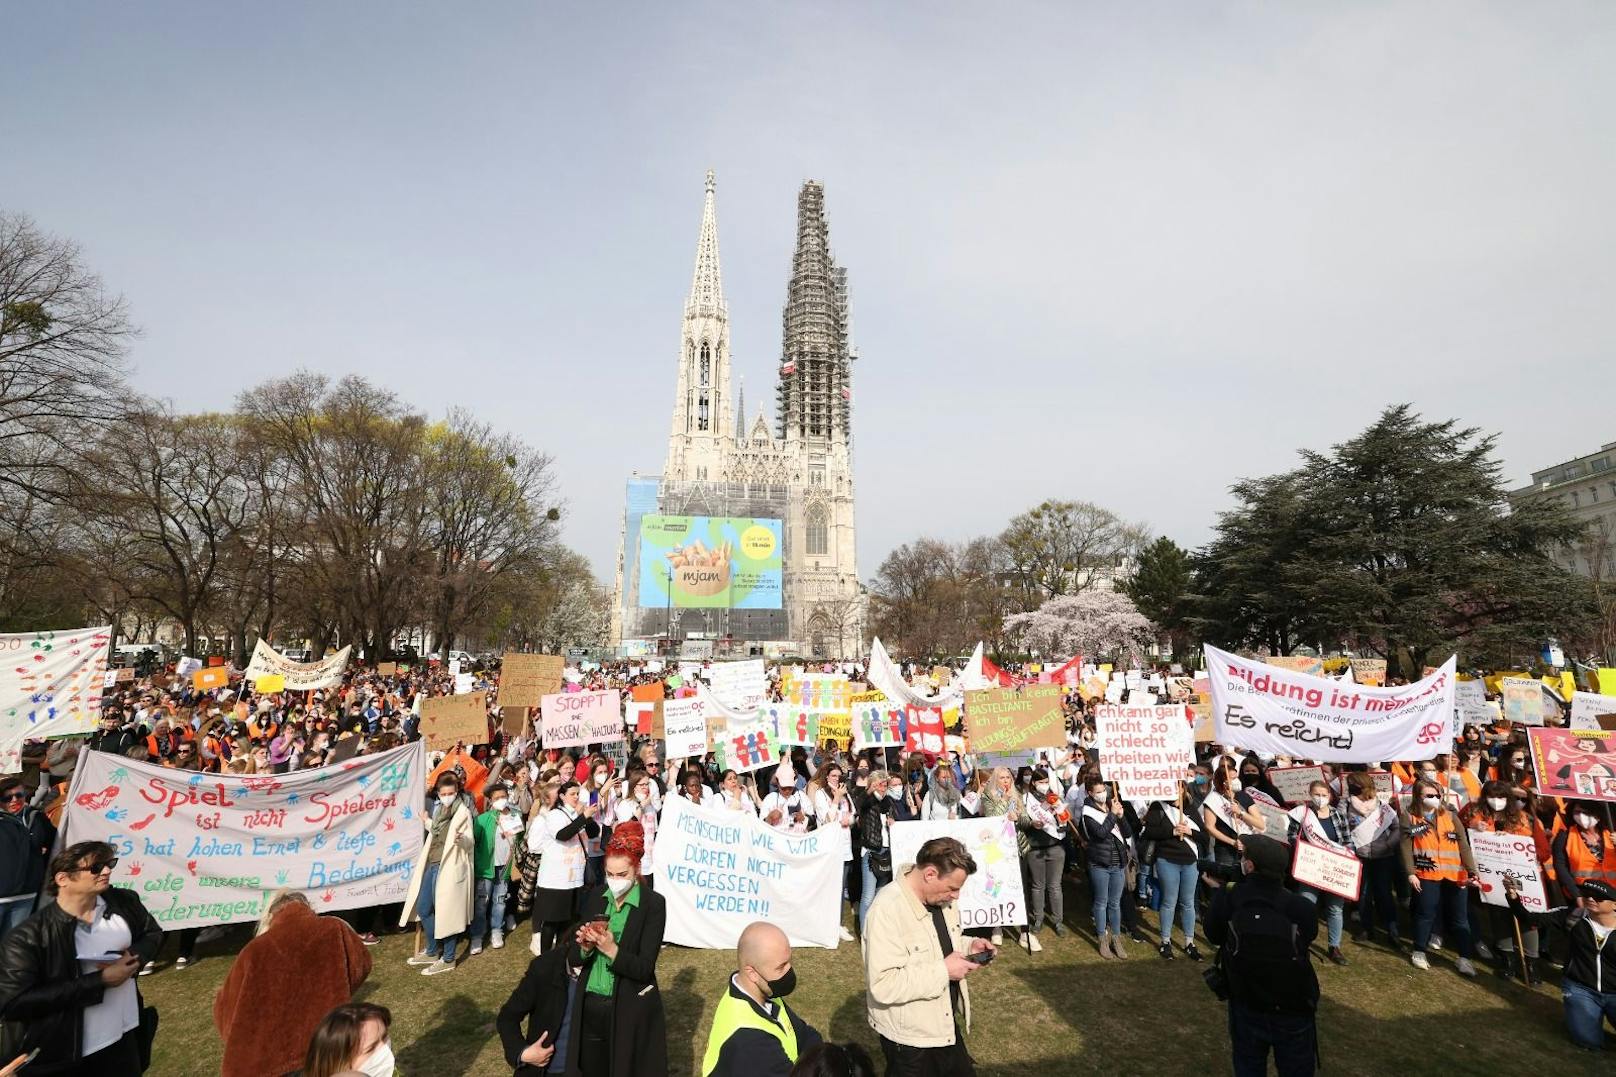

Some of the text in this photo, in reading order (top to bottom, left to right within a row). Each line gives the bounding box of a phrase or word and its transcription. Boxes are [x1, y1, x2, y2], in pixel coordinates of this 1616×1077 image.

[683, 569, 721, 586] mjam
[1001, 689, 1021, 701] bin
[1026, 687, 1058, 699] keine
[1227, 682, 1245, 692] Die
[1332, 714, 1350, 726] der
[1330, 689, 1361, 710] ist
[969, 700, 1033, 715] BASTELTANTE
[1117, 704, 1152, 719] kann
[1155, 706, 1179, 720] gar
[545, 727, 580, 742] MASSEN
[1106, 719, 1168, 734] nicht so
[1224, 703, 1353, 751] Es reicht!
[1105, 733, 1167, 749] schlecht
[1099, 749, 1190, 765] arbeiten wie
[1107, 765, 1189, 781] ich bezahlt
[139, 778, 234, 818] Spiel
[195, 791, 397, 831] ist nicht Spielerei
[676, 812, 741, 844] MENSCHEN
[107, 829, 376, 858] Es hat hohen Ernst & tiefe
[750, 830, 818, 855] WIE WIR
[684, 842, 786, 880] DÜRFEN NICHT
[1477, 863, 1492, 875] Es
[143, 873, 184, 892] wie
[198, 873, 261, 889] unsere
[667, 863, 760, 897] VERGESSEN
[695, 893, 770, 917] WERDEN!!
[963, 902, 1016, 926] JOB!?
